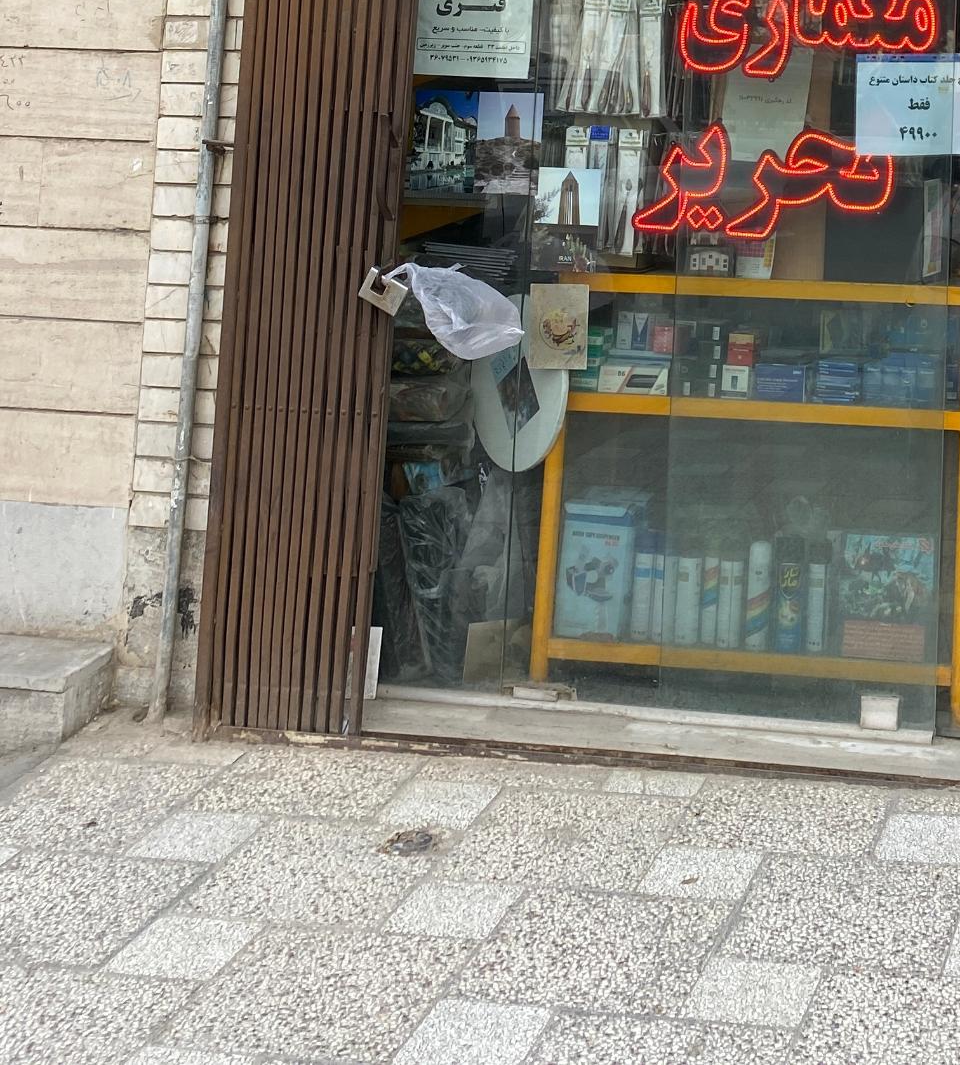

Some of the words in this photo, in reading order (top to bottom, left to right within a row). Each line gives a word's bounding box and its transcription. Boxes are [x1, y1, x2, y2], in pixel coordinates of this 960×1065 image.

[868, 76, 891, 87] متنوع
[892, 74, 918, 87] داستان
[919, 74, 938, 86] کتاب
[908, 97, 931, 111] فقط
[899, 126, 938, 141] ۴۹۹۰۰
